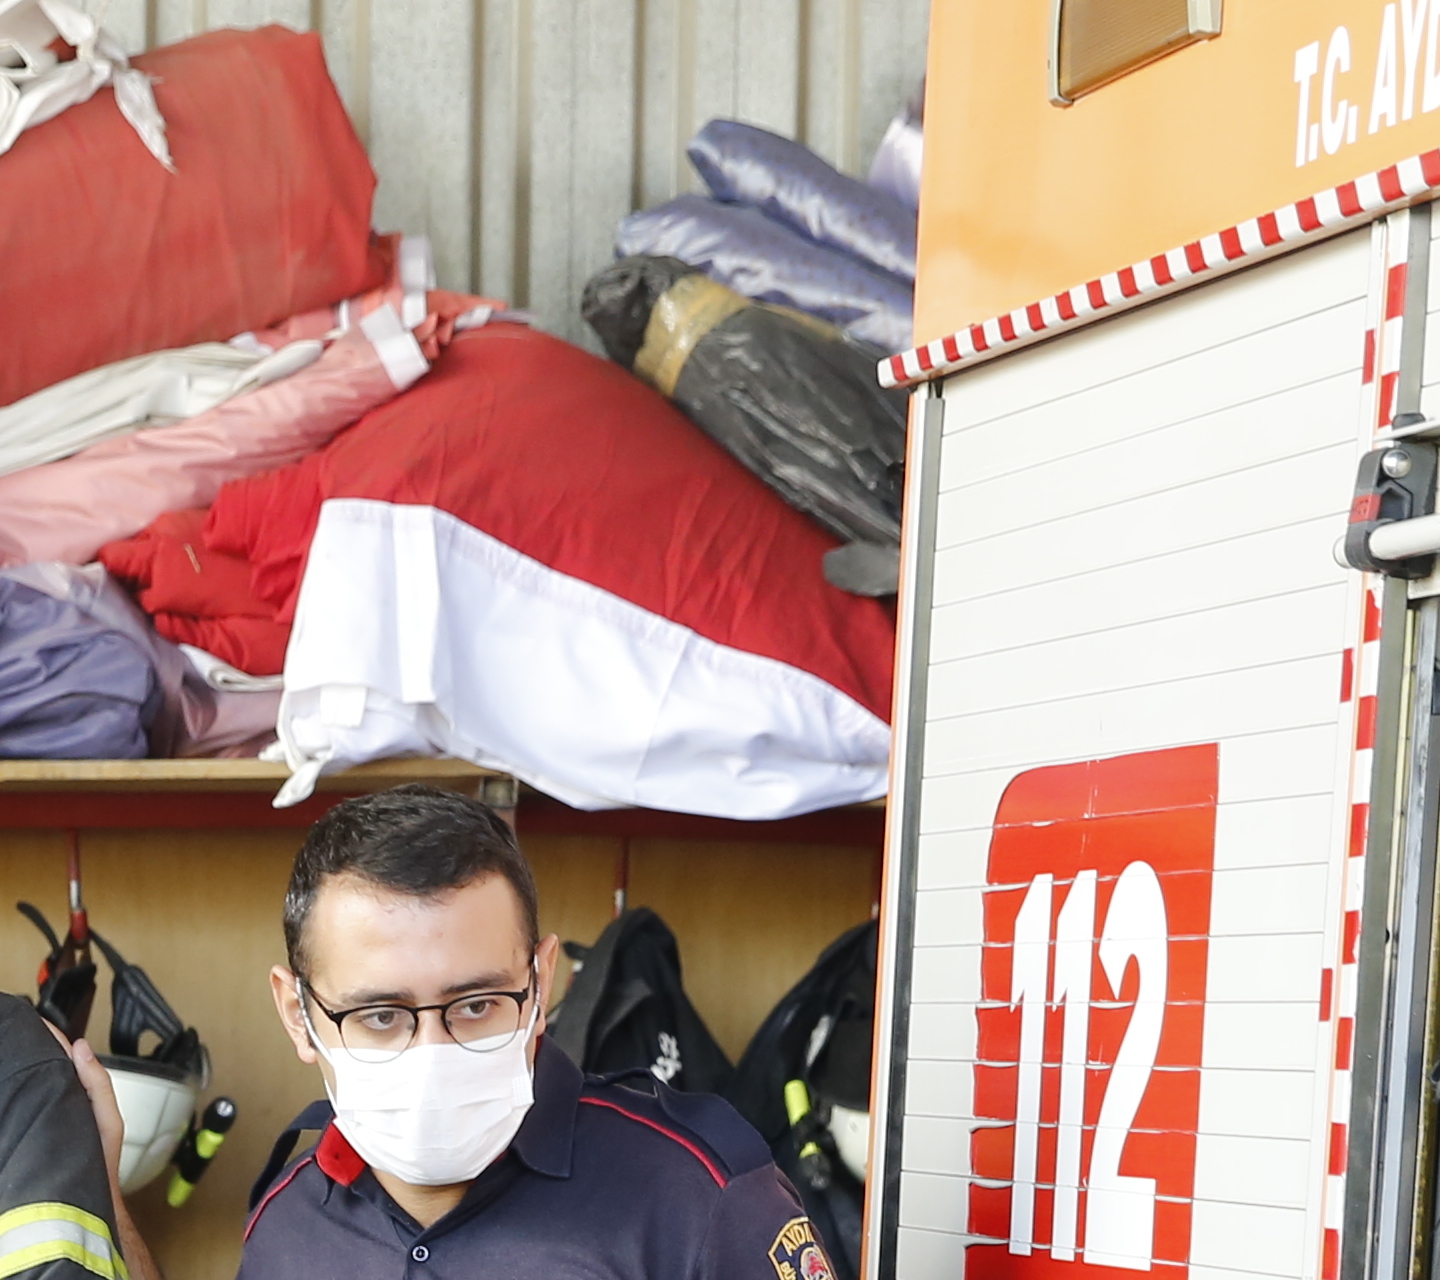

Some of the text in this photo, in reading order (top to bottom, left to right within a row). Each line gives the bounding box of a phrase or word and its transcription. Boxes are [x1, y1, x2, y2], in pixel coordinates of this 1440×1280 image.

[1294, 25, 1358, 168] T.C.
[1008, 860, 1168, 1272] 112
[781, 1222, 816, 1257] AYDI
